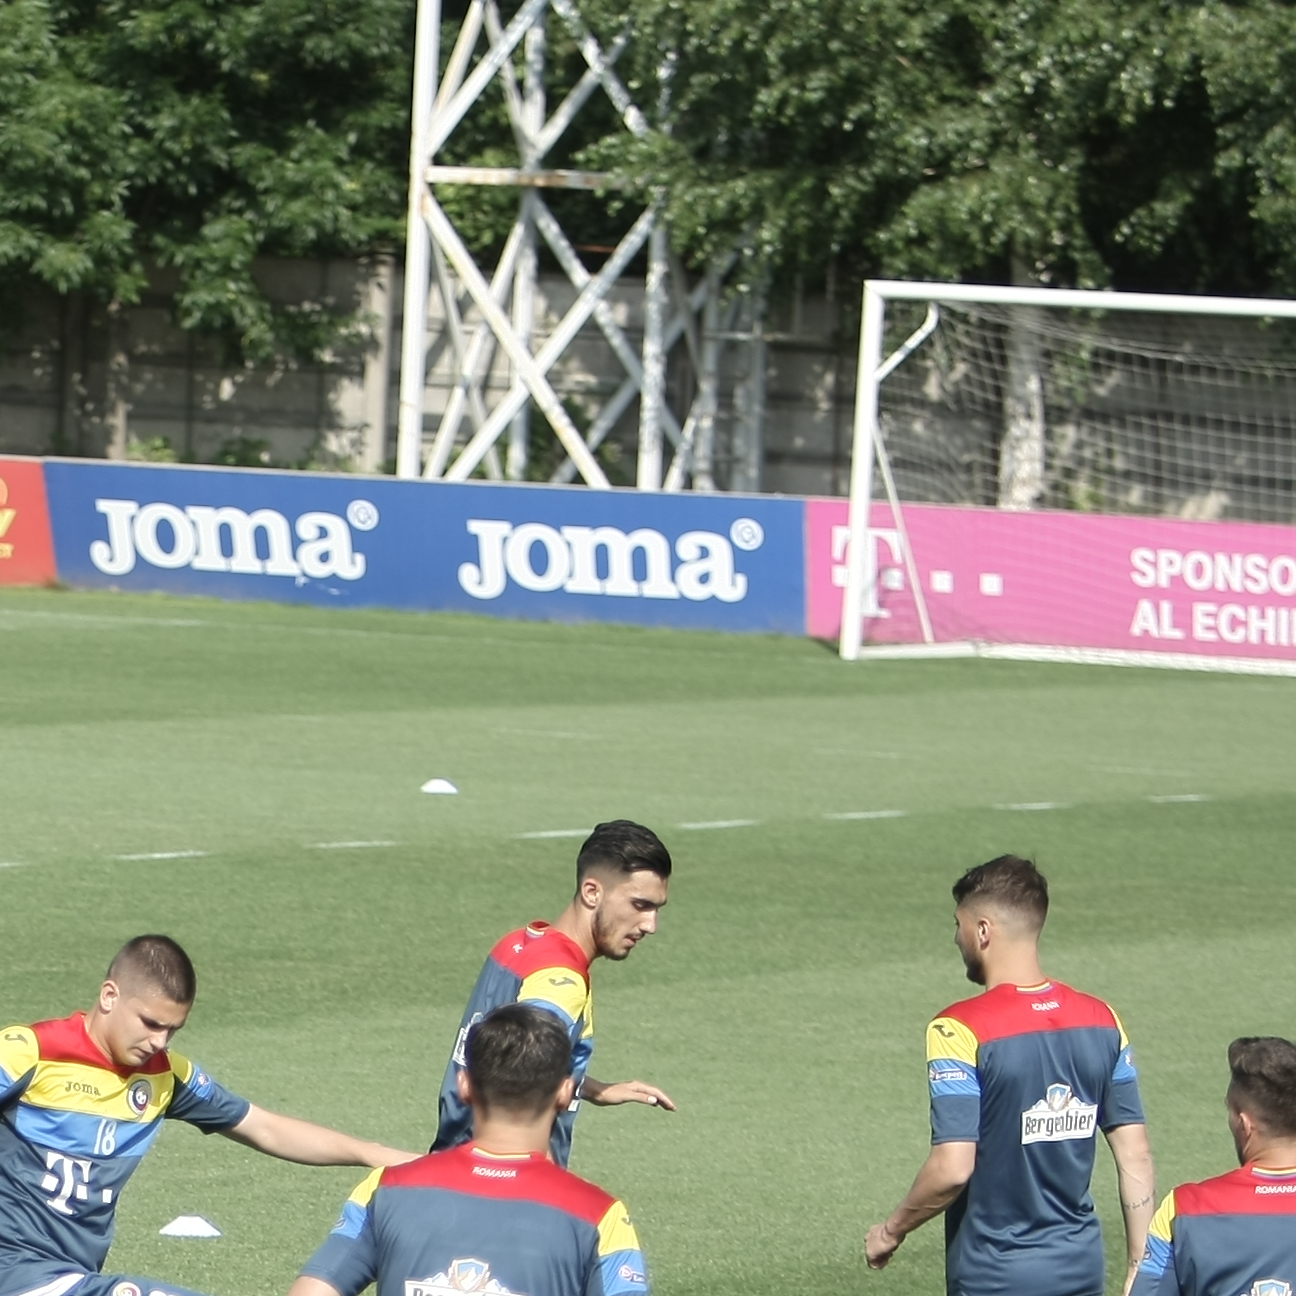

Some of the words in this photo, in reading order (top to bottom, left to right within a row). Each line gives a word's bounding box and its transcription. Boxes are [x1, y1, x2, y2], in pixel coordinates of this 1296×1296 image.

[1129, 598, 1186, 640] AL
[1192, 601, 1296, 646] ECHI
[93, 1119, 118, 1156] 18
[1024, 1110, 1094, 1137] Bergenbier
